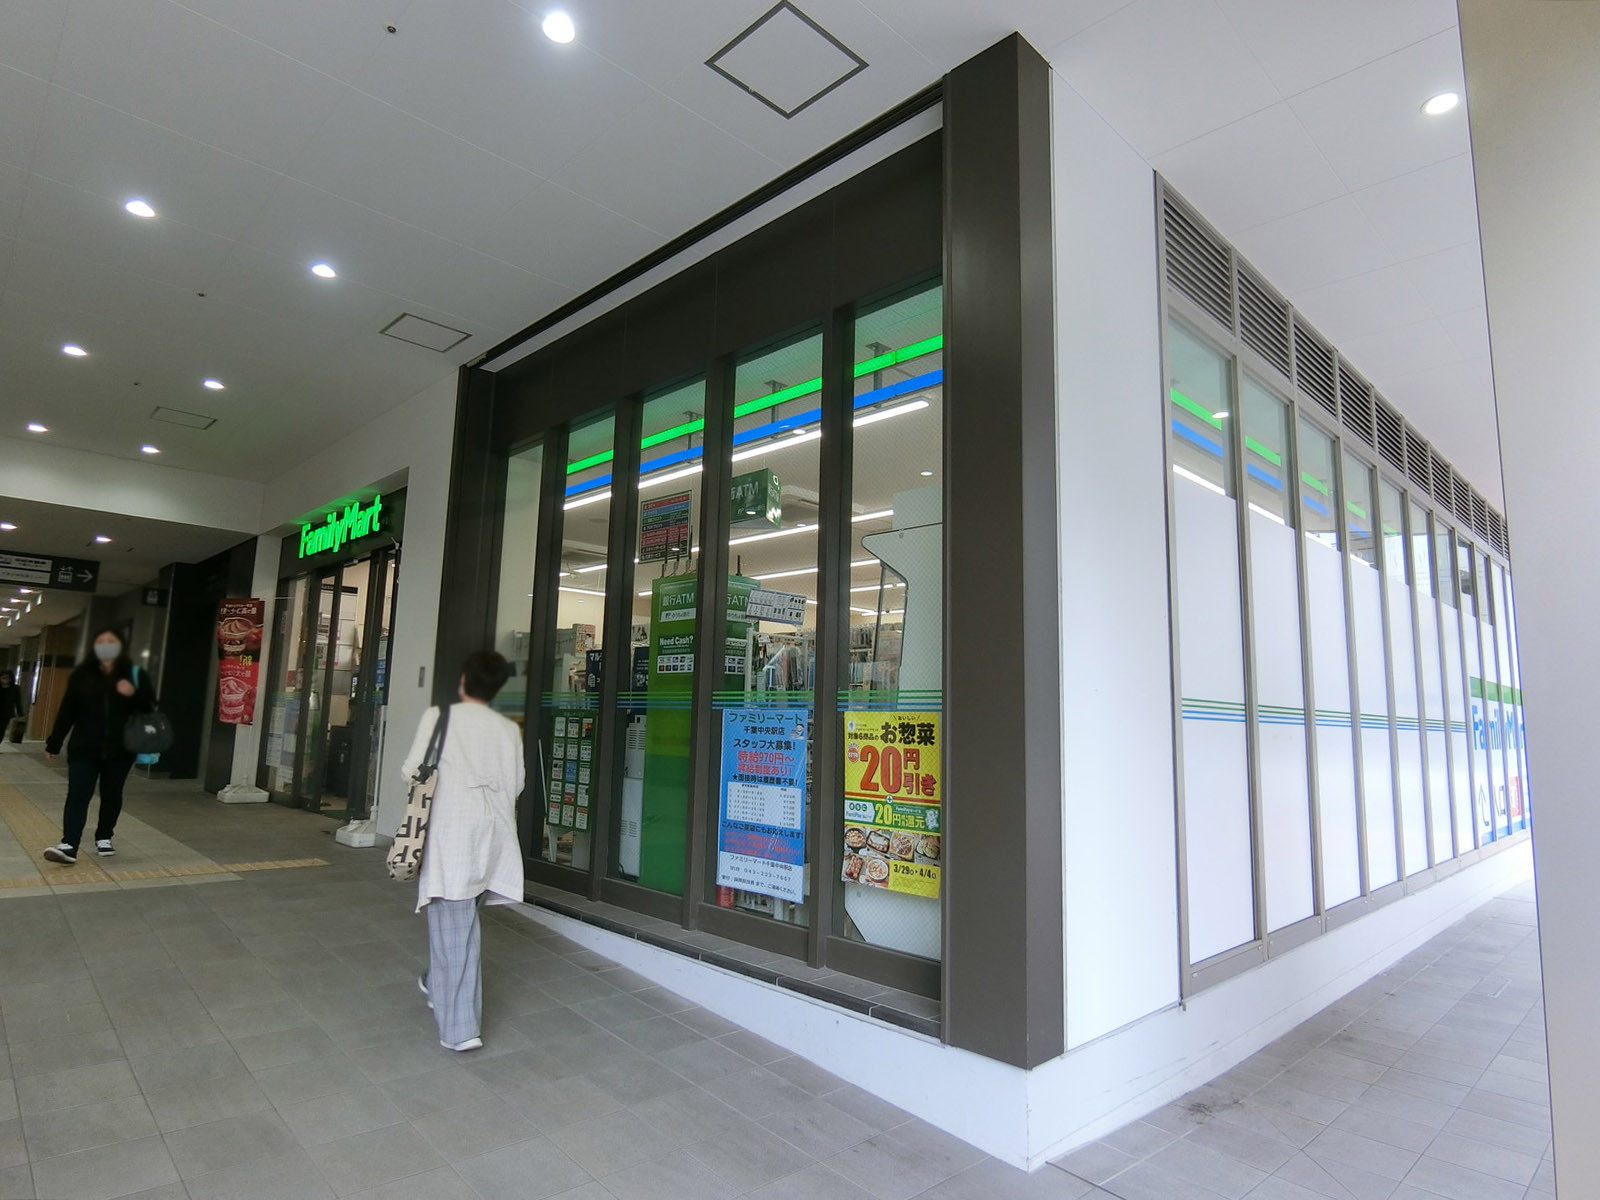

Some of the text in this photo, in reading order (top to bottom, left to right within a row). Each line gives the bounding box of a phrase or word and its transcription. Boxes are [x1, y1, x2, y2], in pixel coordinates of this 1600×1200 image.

[299, 494, 382, 558] FamilyMart
[662, 593, 694, 607] 銀行ATM
[659, 635, 694, 646] Need Cash?
[729, 713, 803, 728] ファミリーマート
[743, 725, 785, 736] 千葉中央駅店
[880, 721, 935, 746] お惣菜
[860, 744, 902, 794] 20
[903, 772, 937, 797] 引き
